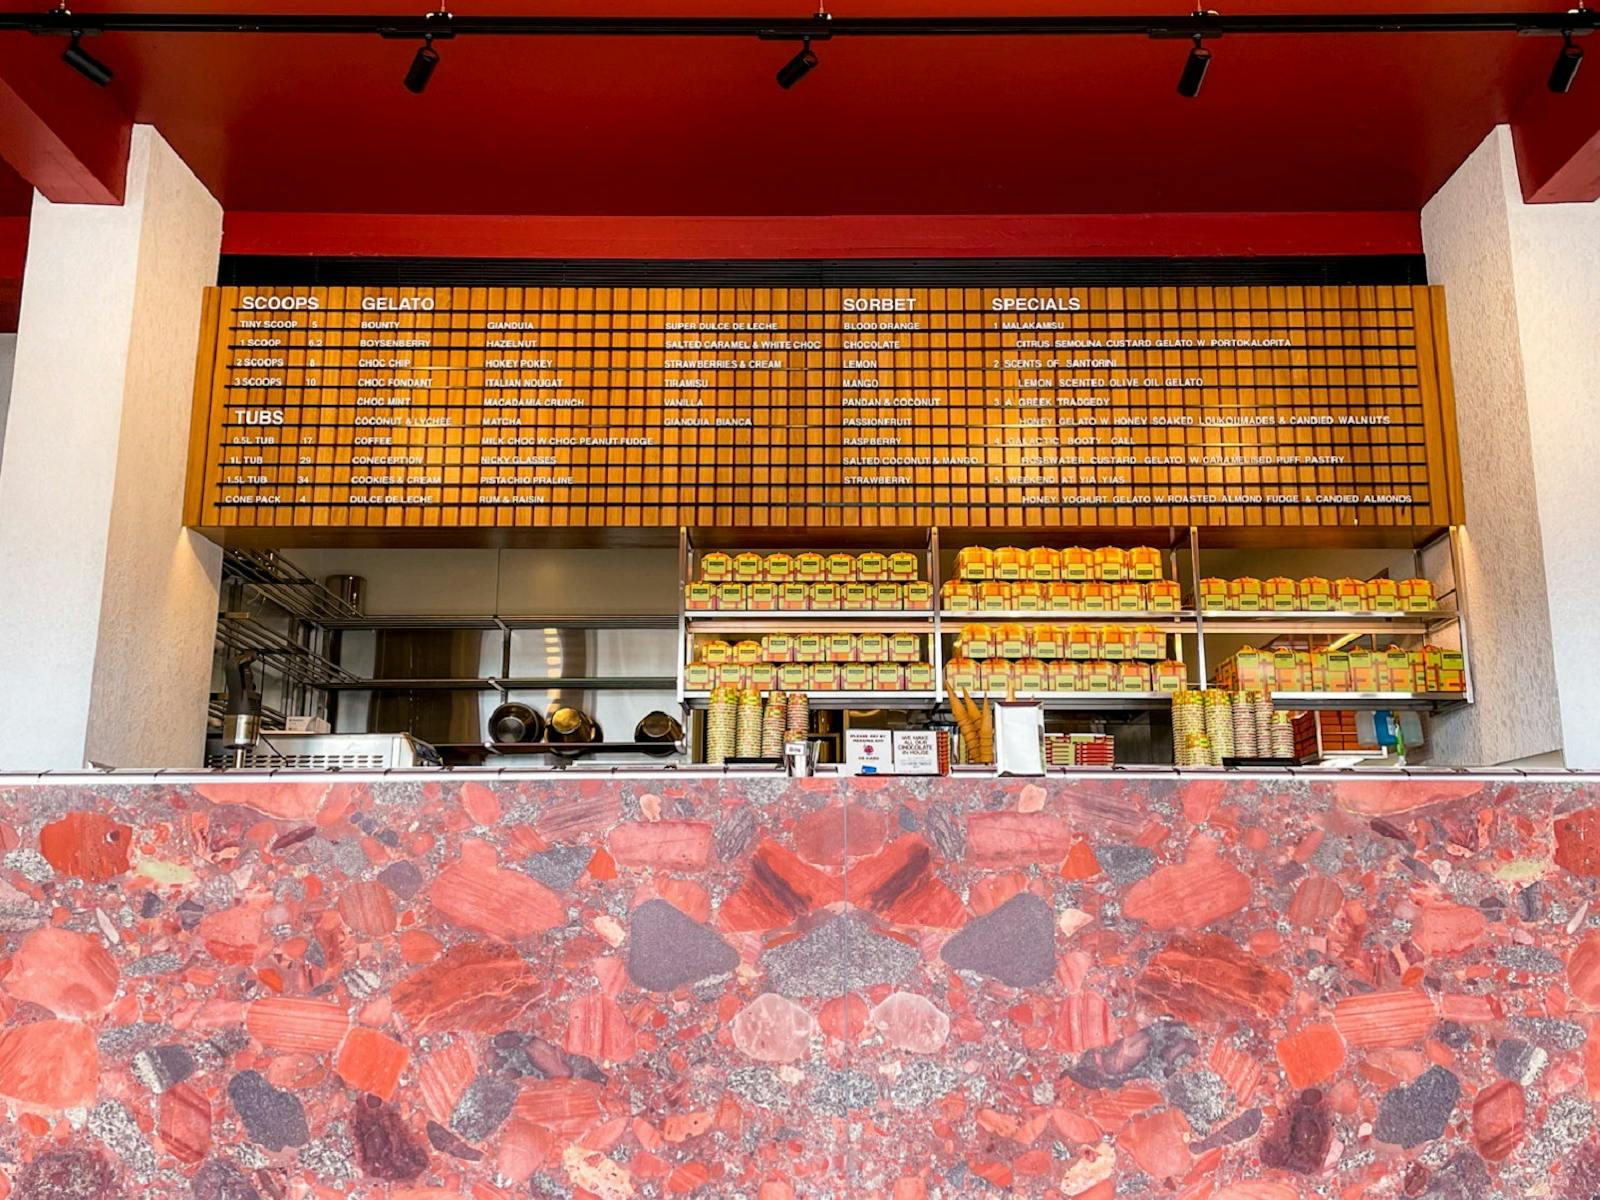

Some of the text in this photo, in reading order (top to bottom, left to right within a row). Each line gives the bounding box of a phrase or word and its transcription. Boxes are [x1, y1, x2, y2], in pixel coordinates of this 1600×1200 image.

[242, 297, 319, 310] SCOOPS
[362, 297, 434, 310] GELATO
[843, 298, 916, 311] SORBET
[992, 298, 1080, 310] SPECIALS
[844, 322, 920, 330] BLOOD ORANGE
[248, 339, 281, 347] SCOOP
[486, 340, 537, 348] HAZELNUT
[665, 341, 821, 349] SALTED CARAMEL & WHITE CHOC
[843, 341, 900, 349] CHOCOLATE
[1016, 340, 1050, 348] CITRUS
[1055, 340, 1101, 348] SEMOLINA
[1106, 340, 1151, 348] CUSTARD
[236, 359, 283, 367] 2 SCOOPS
[359, 359, 410, 367] CHOC CHIP
[485, 359, 552, 368] HOKEY POKEY
[664, 360, 781, 369] STRAWBERRIES & CREAM
[843, 360, 877, 368] LEMON
[994, 360, 1116, 368] 2 SCENTS OF SANTORINI
[234, 378, 316, 386] 3 SCOOPS 10
[358, 378, 432, 387] CHOC FONDANT
[485, 379, 563, 388] ITALIAN NOUGAT
[664, 379, 708, 388] TIRAMISU
[842, 379, 879, 387] MANGO
[1018, 378, 1203, 387] LEMON SCENTED OLIVE OIL GELATO
[484, 398, 584, 407] MACADAMIA CRUNCH
[842, 398, 940, 406] PANDAN COCONUT
[994, 398, 1110, 406] 3 A GREEK TRADGEDY
[235, 411, 283, 424] TUBS
[1019, 416, 1390, 425] HONEY GELATO W HONEY SOAKED LOUKOUMADES & CANDIED WALNUTS
[482, 418, 522, 426] MATCHA
[664, 418, 752, 426] GIANDUIA BIANCA
[843, 418, 912, 426] PASSIONFRUIT
[354, 437, 392, 445] COFFEE
[482, 437, 653, 445] MILK CHOC W CHOC PEANUT FUDGE
[843, 437, 901, 445] RASPBERRY
[1068, 437, 1134, 445] BOOTY CALL
[481, 456, 556, 464] NICKY GLASSES
[842, 457, 978, 465] SALTED COCONUT MANGO
[1090, 457, 1137, 465] CUSTARD
[1144, 456, 1182, 464] GELATO
[1277, 456, 1301, 464] PUFF
[1305, 456, 1344, 464] PASTRY
[351, 476, 442, 484] COOKIES CREAM
[480, 476, 573, 484] PISTACHIO PRALINE
[844, 476, 911, 484] STRAWBERRY
[1062, 476, 1074, 484] AT
[1079, 476, 1096, 484] YIA
[1101, 476, 1125, 484] YIAS
[225, 495, 306, 503] CONE PACK 4
[1168, 495, 1217, 503] ROASTED
[1222, 495, 1262, 503] ALMOND
[1267, 495, 1298, 503] FUDGE
[1315, 495, 1359, 503] CANDIED
[1364, 495, 1412, 503] ALMONDS
